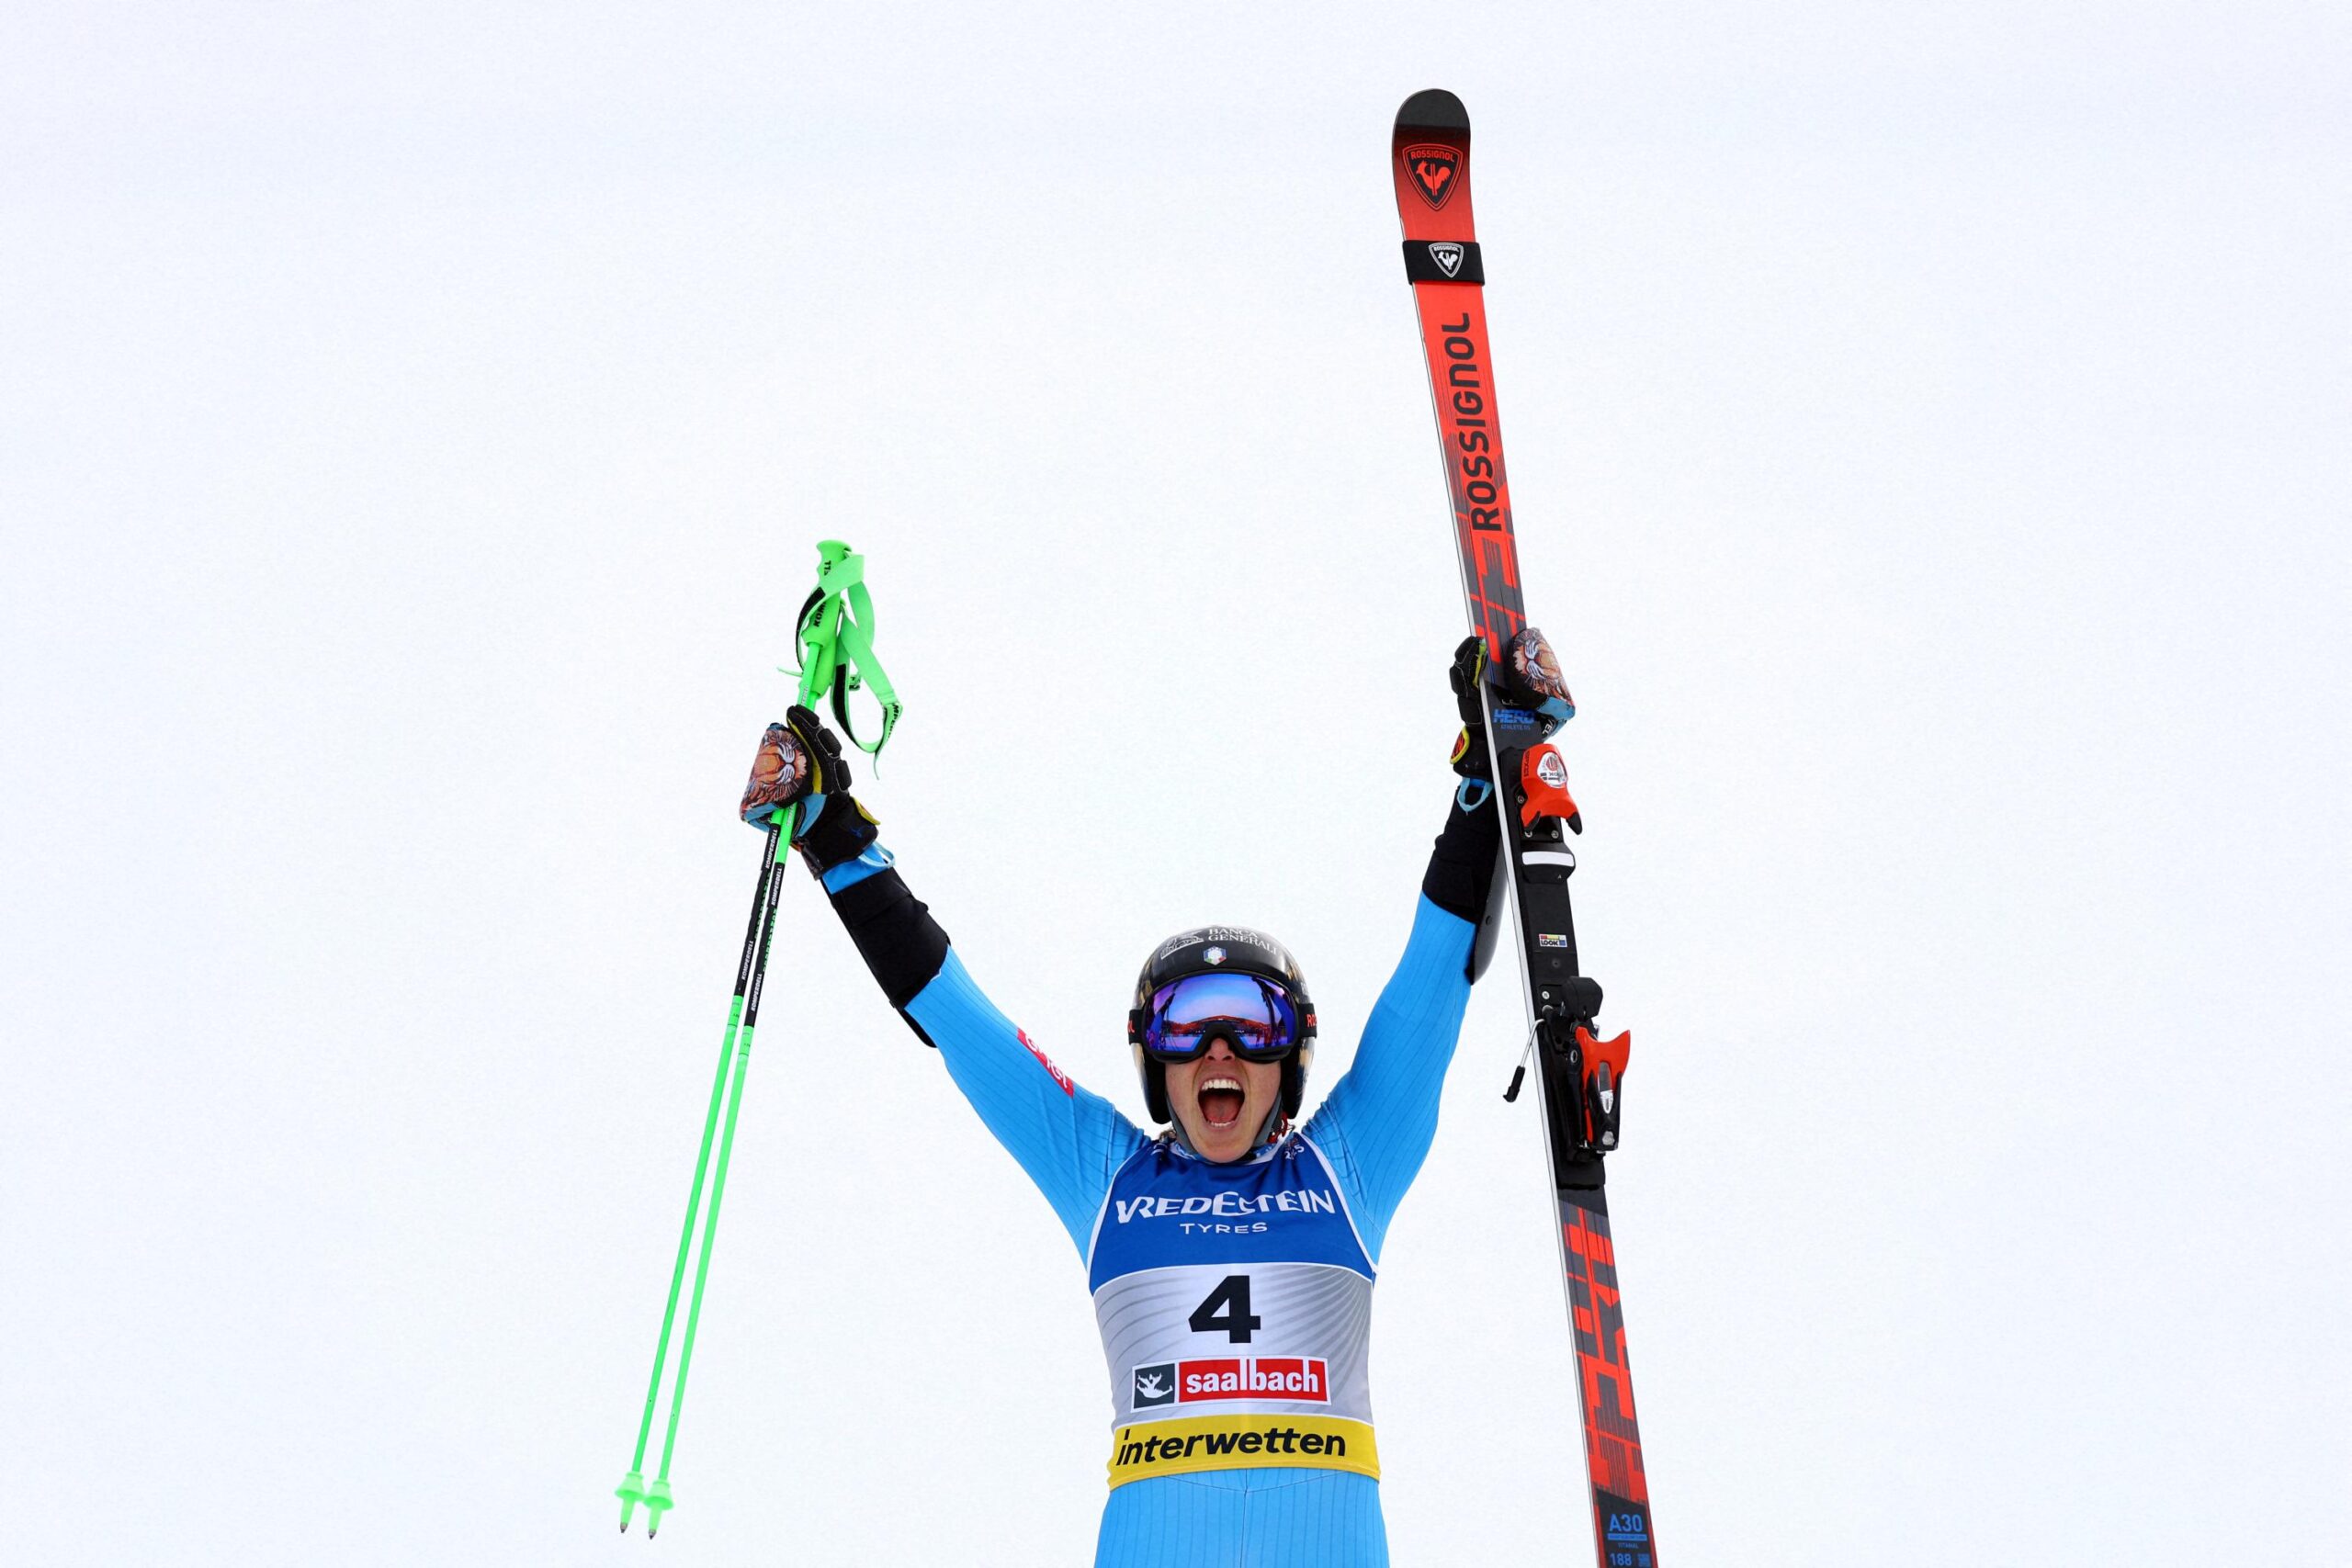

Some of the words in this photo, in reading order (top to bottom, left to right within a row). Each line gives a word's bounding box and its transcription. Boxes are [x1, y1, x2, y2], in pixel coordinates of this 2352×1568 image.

[1410, 150, 1454, 163] ROSSIGNOL
[1442, 312, 1502, 531] ROSSIGNOL
[765, 829, 778, 869] KOMPERDELL
[771, 867, 782, 906] KOMPERDELL
[1208, 928, 1258, 937] BANCA
[1208, 934, 1277, 955] GENERALI
[741, 940, 754, 980] KOMPERDELL
[751, 973, 763, 1011] KOMPERDELL
[1115, 1189, 1335, 1224] VREDESTEIN
[1180, 1222, 1268, 1235] TYRES
[1188, 1275, 1261, 1344] 4
[1186, 1359, 1318, 1393] saalbach
[1116, 1428, 1346, 1466] interwetten
[1609, 1513, 1643, 1532] A30
[1610, 1552, 1632, 1566] 188
